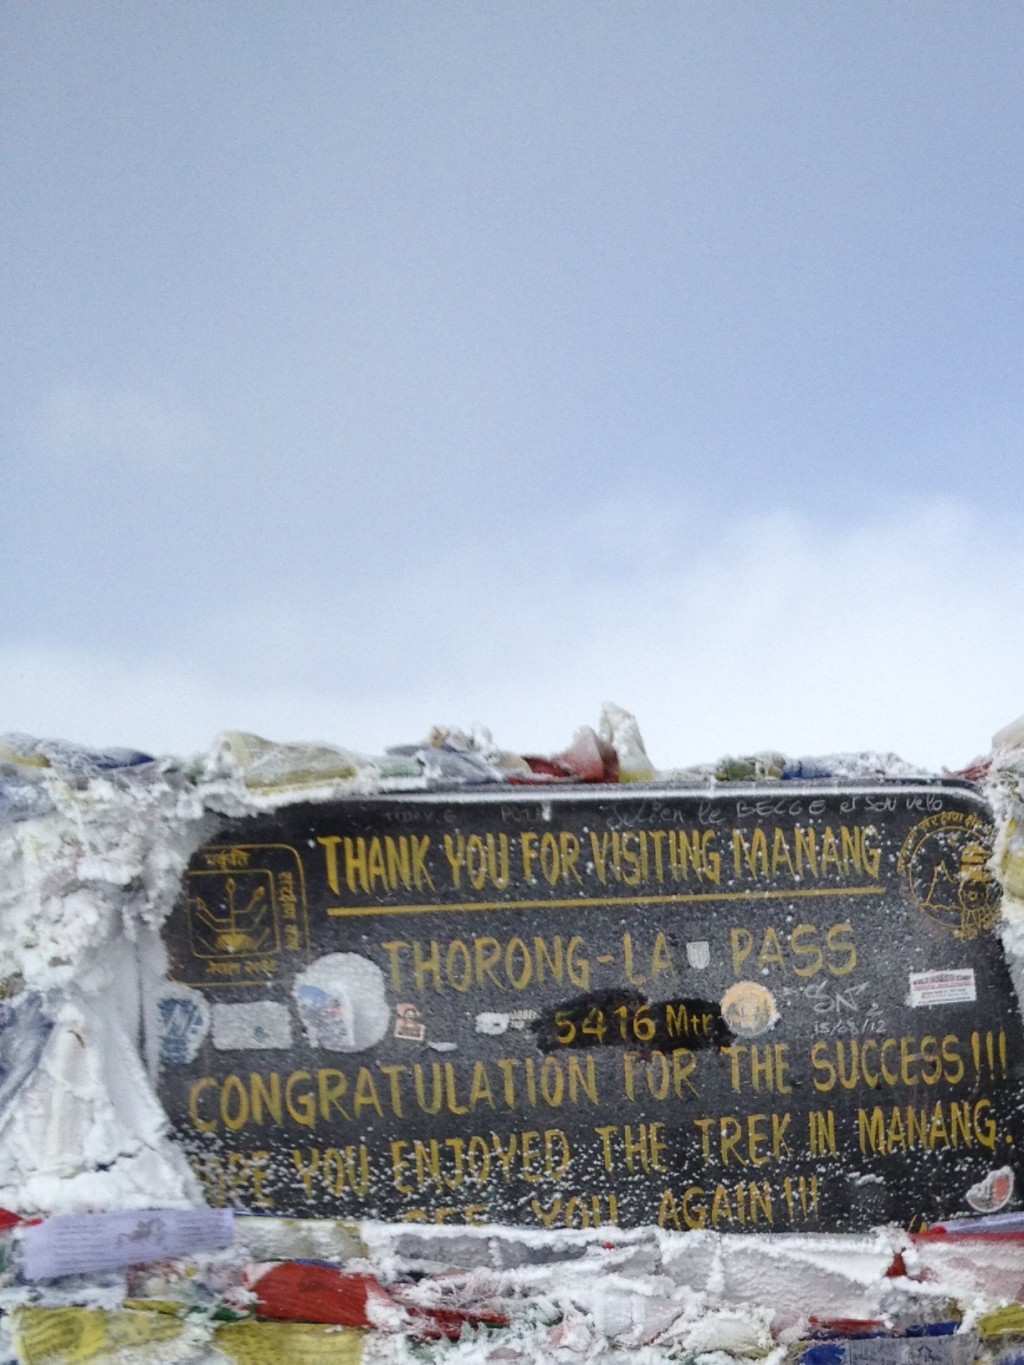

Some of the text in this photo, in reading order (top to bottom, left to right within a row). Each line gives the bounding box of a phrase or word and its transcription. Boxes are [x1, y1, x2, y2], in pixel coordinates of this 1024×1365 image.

[316, 834, 435, 895] THANK
[443, 832, 511, 891] YOU
[520, 831, 583, 886] FOR
[589, 829, 721, 886] VISITING
[731, 825, 881, 881] MANANG
[731, 924, 858, 978] PASS
[555, 1003, 657, 1044] 5416
[188, 1055, 601, 1133] CONGRATULATION
[623, 1048, 700, 1102] FOR
[719, 1044, 792, 1095] THE
[293, 1145, 370, 1198] YOU
[390, 1129, 572, 1196] ENJOYED
[594, 1123, 669, 1176] THE
[695, 1113, 793, 1167] TREK
[808, 1109, 837, 1159] IN
[531, 1194, 620, 1230] YOU
